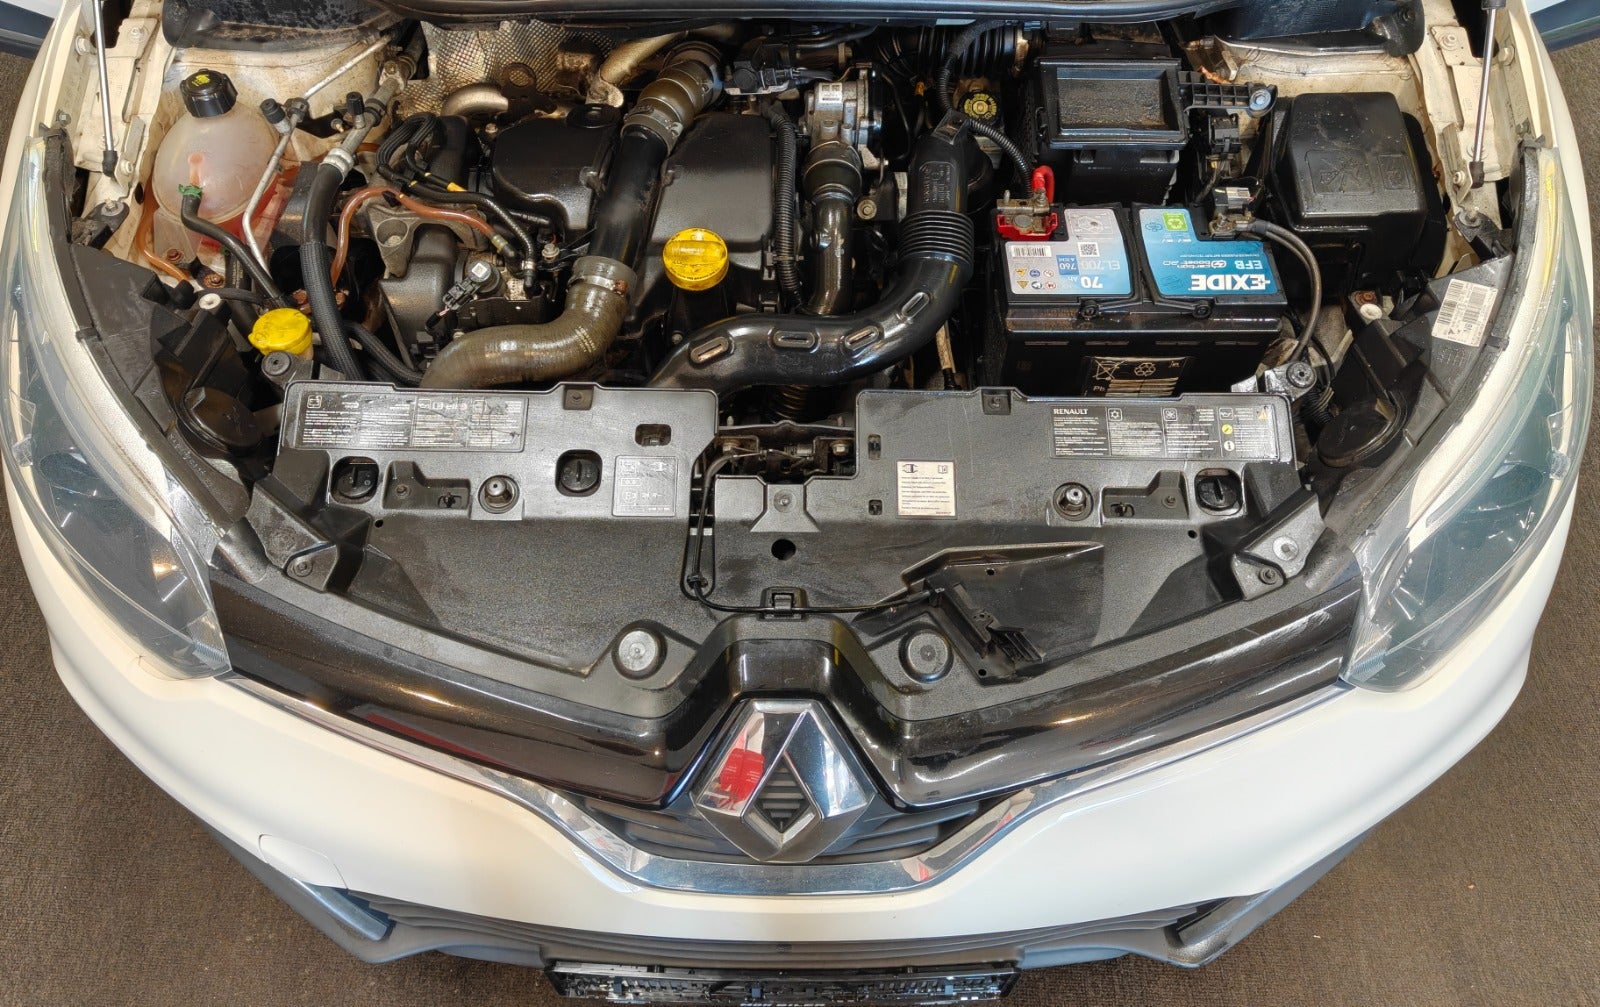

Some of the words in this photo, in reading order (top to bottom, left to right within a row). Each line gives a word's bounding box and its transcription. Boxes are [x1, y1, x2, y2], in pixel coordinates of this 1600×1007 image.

[1059, 262, 1077, 270] 760
[1080, 260, 1121, 271] EL700
[1234, 260, 1263, 270] EFB
[1080, 276, 1103, 289] 70
[1190, 274, 1270, 291] EXIDE
